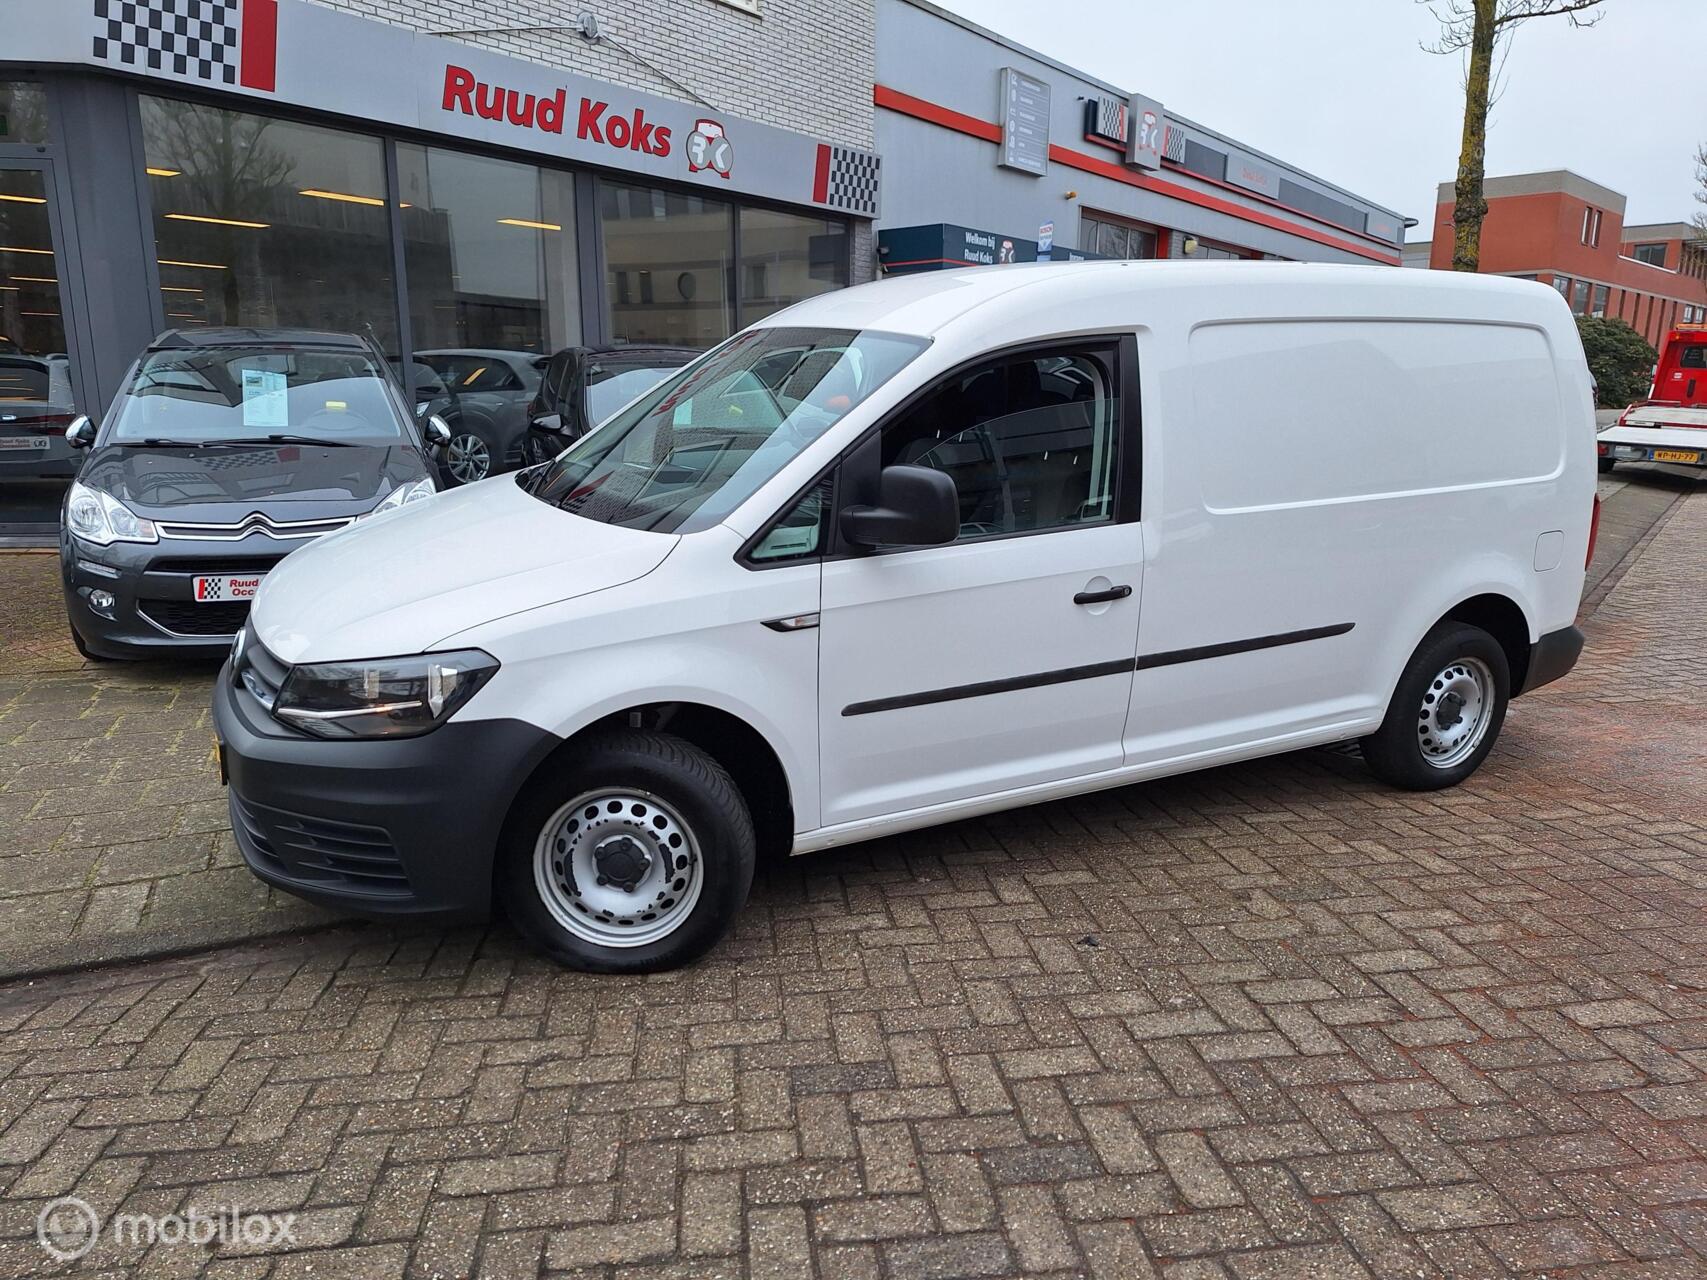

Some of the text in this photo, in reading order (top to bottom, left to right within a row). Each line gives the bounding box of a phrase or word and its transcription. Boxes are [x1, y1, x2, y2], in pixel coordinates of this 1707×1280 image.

[442, 64, 672, 158] Ruud Koks
[965, 231, 996, 250] Welkom bij
[964, 248, 993, 264] Ruud Koks
[230, 579, 259, 587] Ruud
